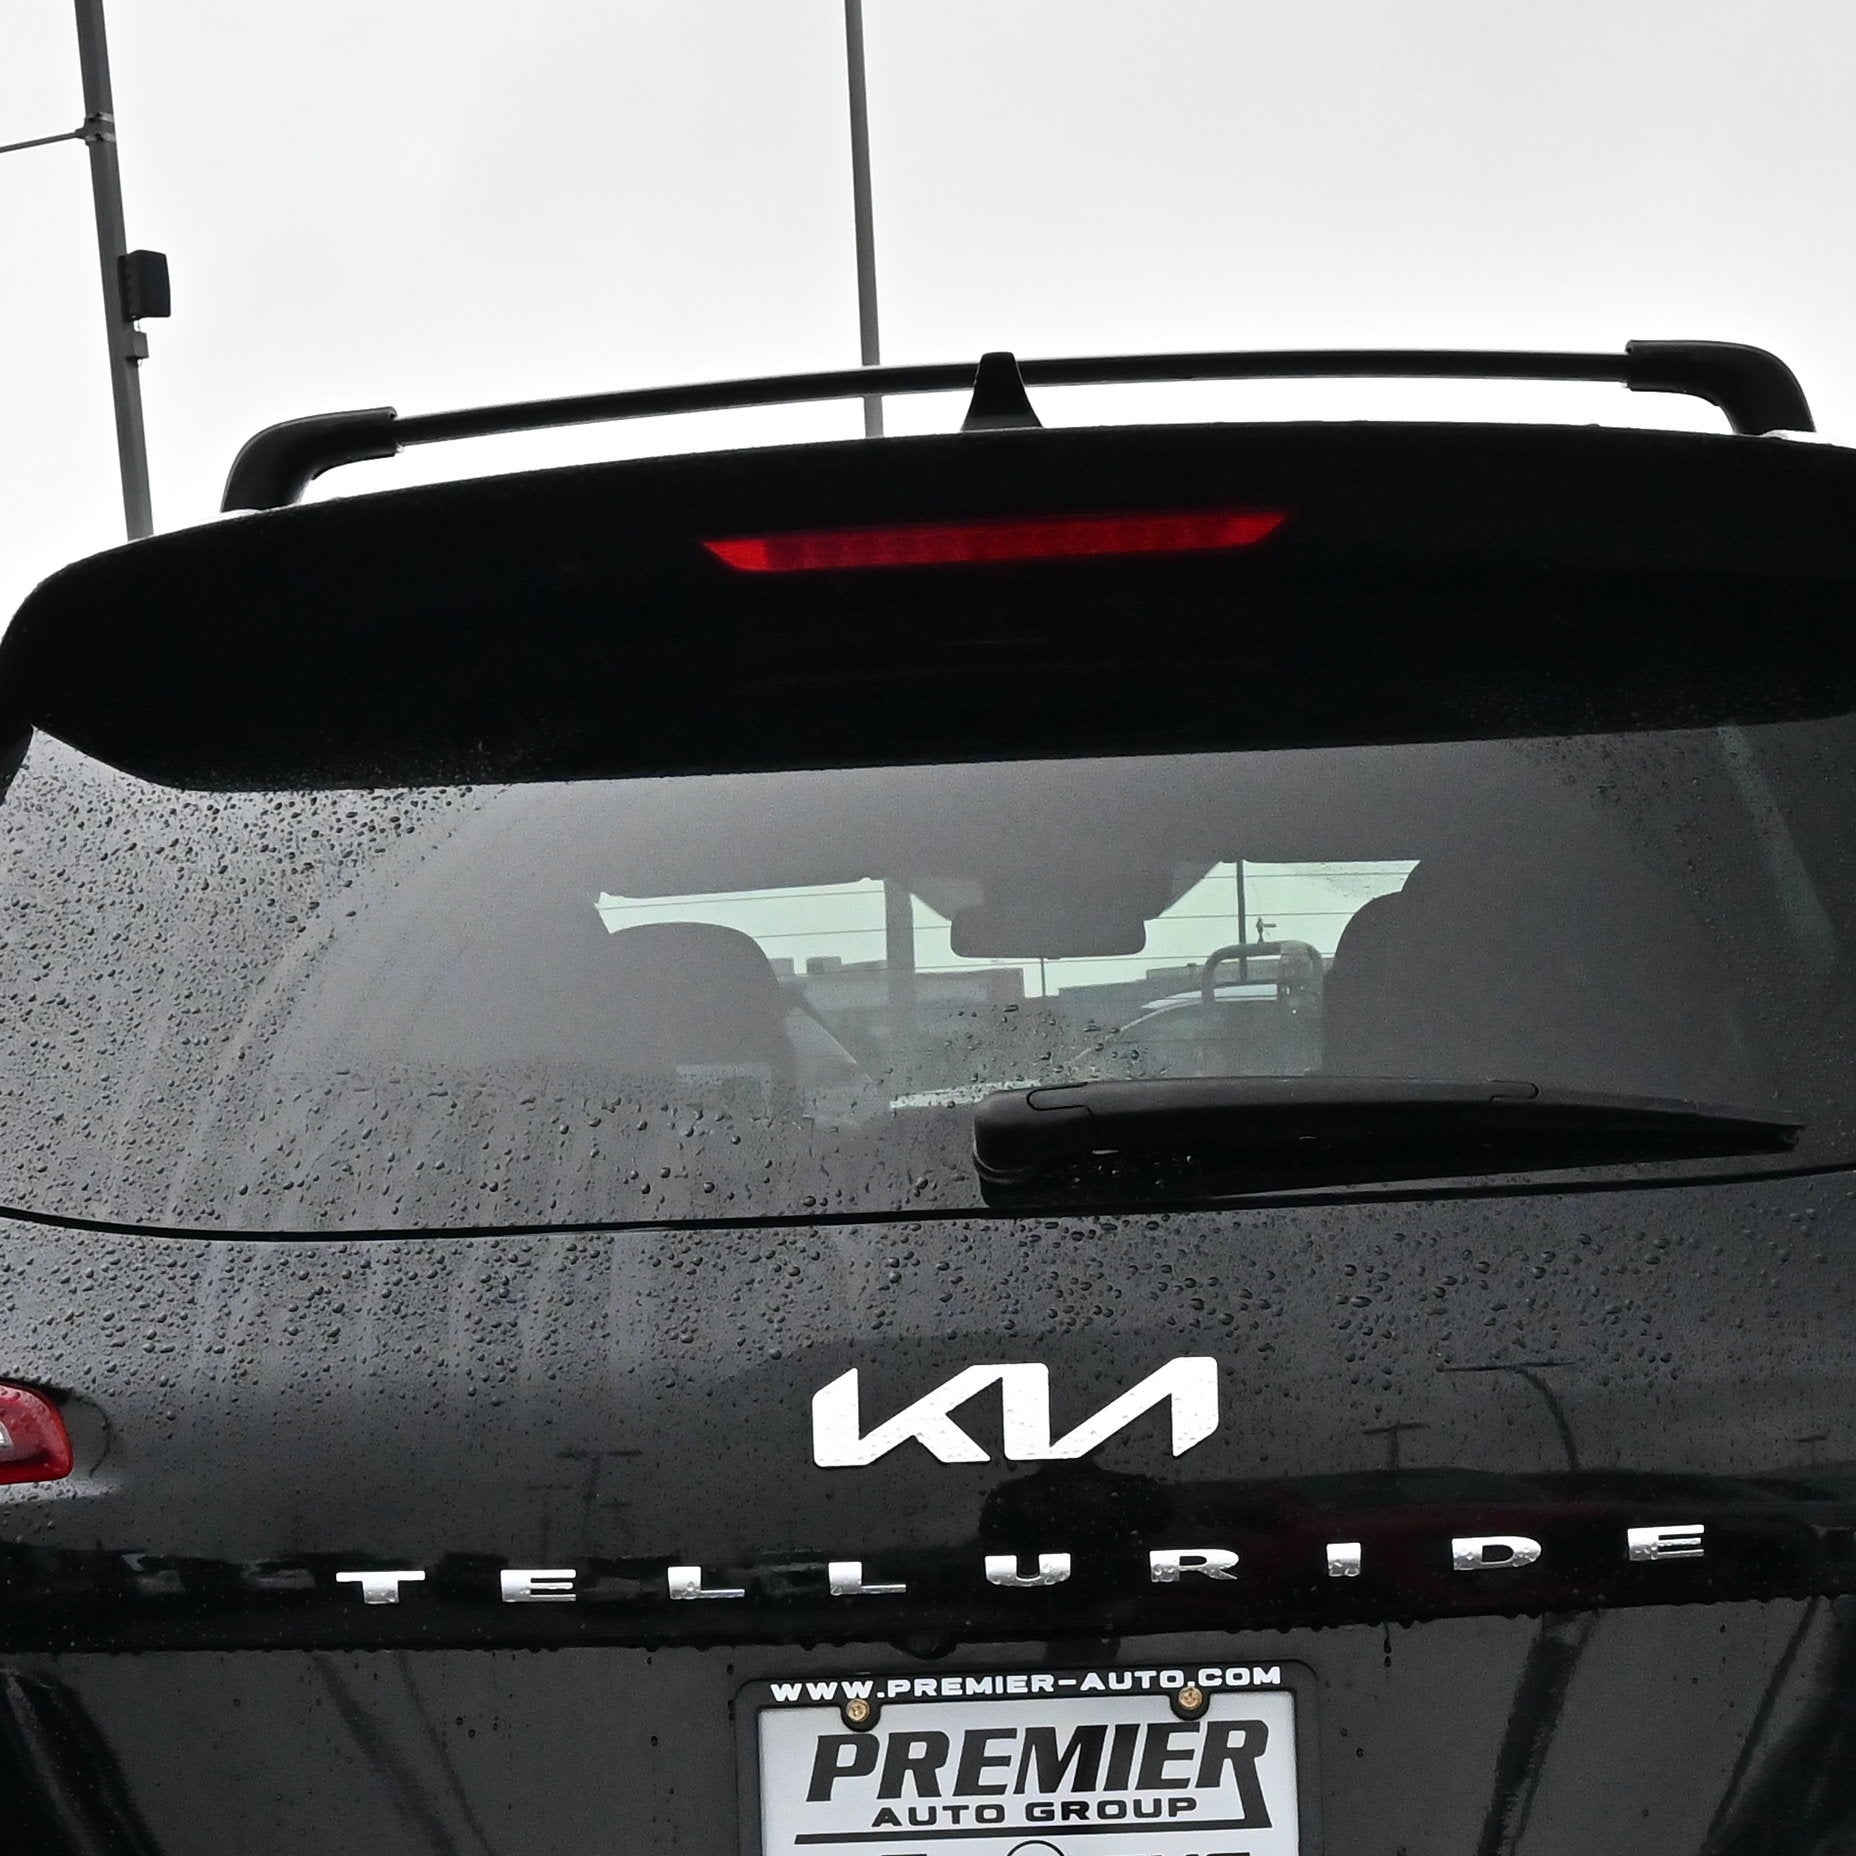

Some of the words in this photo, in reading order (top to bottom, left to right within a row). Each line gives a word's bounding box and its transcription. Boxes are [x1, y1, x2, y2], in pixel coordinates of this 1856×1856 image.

[336, 1524, 1705, 1604] TELLURIDE
[770, 1666, 1281, 1701] WWW.PREMIER-AUTO.COM
[805, 1719, 1272, 1812] PREMIER
[871, 1803, 1006, 1828] AUTO
[1025, 1796, 1198, 1821] GROUP
